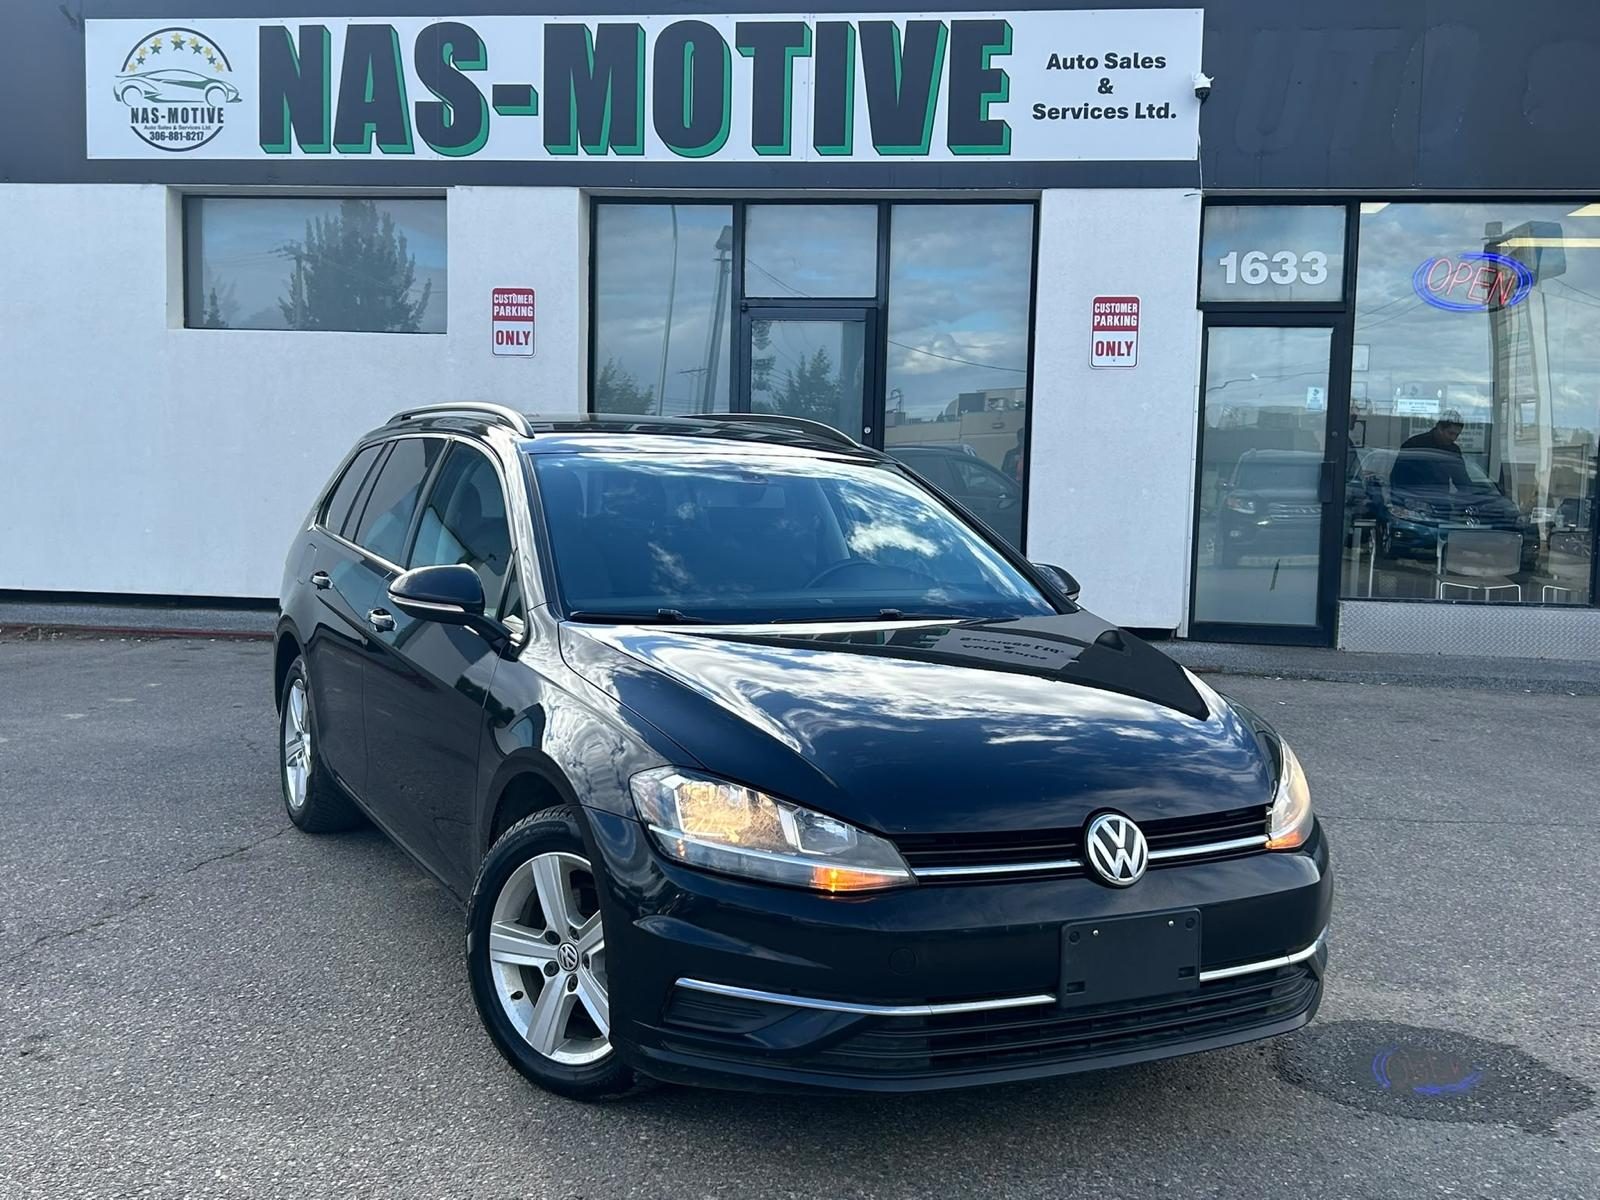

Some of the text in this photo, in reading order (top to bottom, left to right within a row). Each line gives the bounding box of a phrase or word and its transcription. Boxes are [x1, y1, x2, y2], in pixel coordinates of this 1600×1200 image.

[1046, 52, 1167, 70] Auto Sales
[259, 19, 1013, 158] NAS-MOTIVE
[1097, 77, 1114, 94] &
[131, 107, 224, 124] NAS-MOTIVE
[1032, 102, 1177, 120] Services Ltd.
[1219, 250, 1328, 285] 1633
[1427, 257, 1516, 305] OPEN
[494, 293, 534, 304] CUSTOMER
[494, 305, 534, 317] PARKING
[1094, 302, 1138, 313] CUSTOMER
[1094, 315, 1137, 326] PARKING
[496, 330, 531, 346] ONLY
[1095, 340, 1134, 356] ONLY
[1087, 813, 1149, 886] VW
